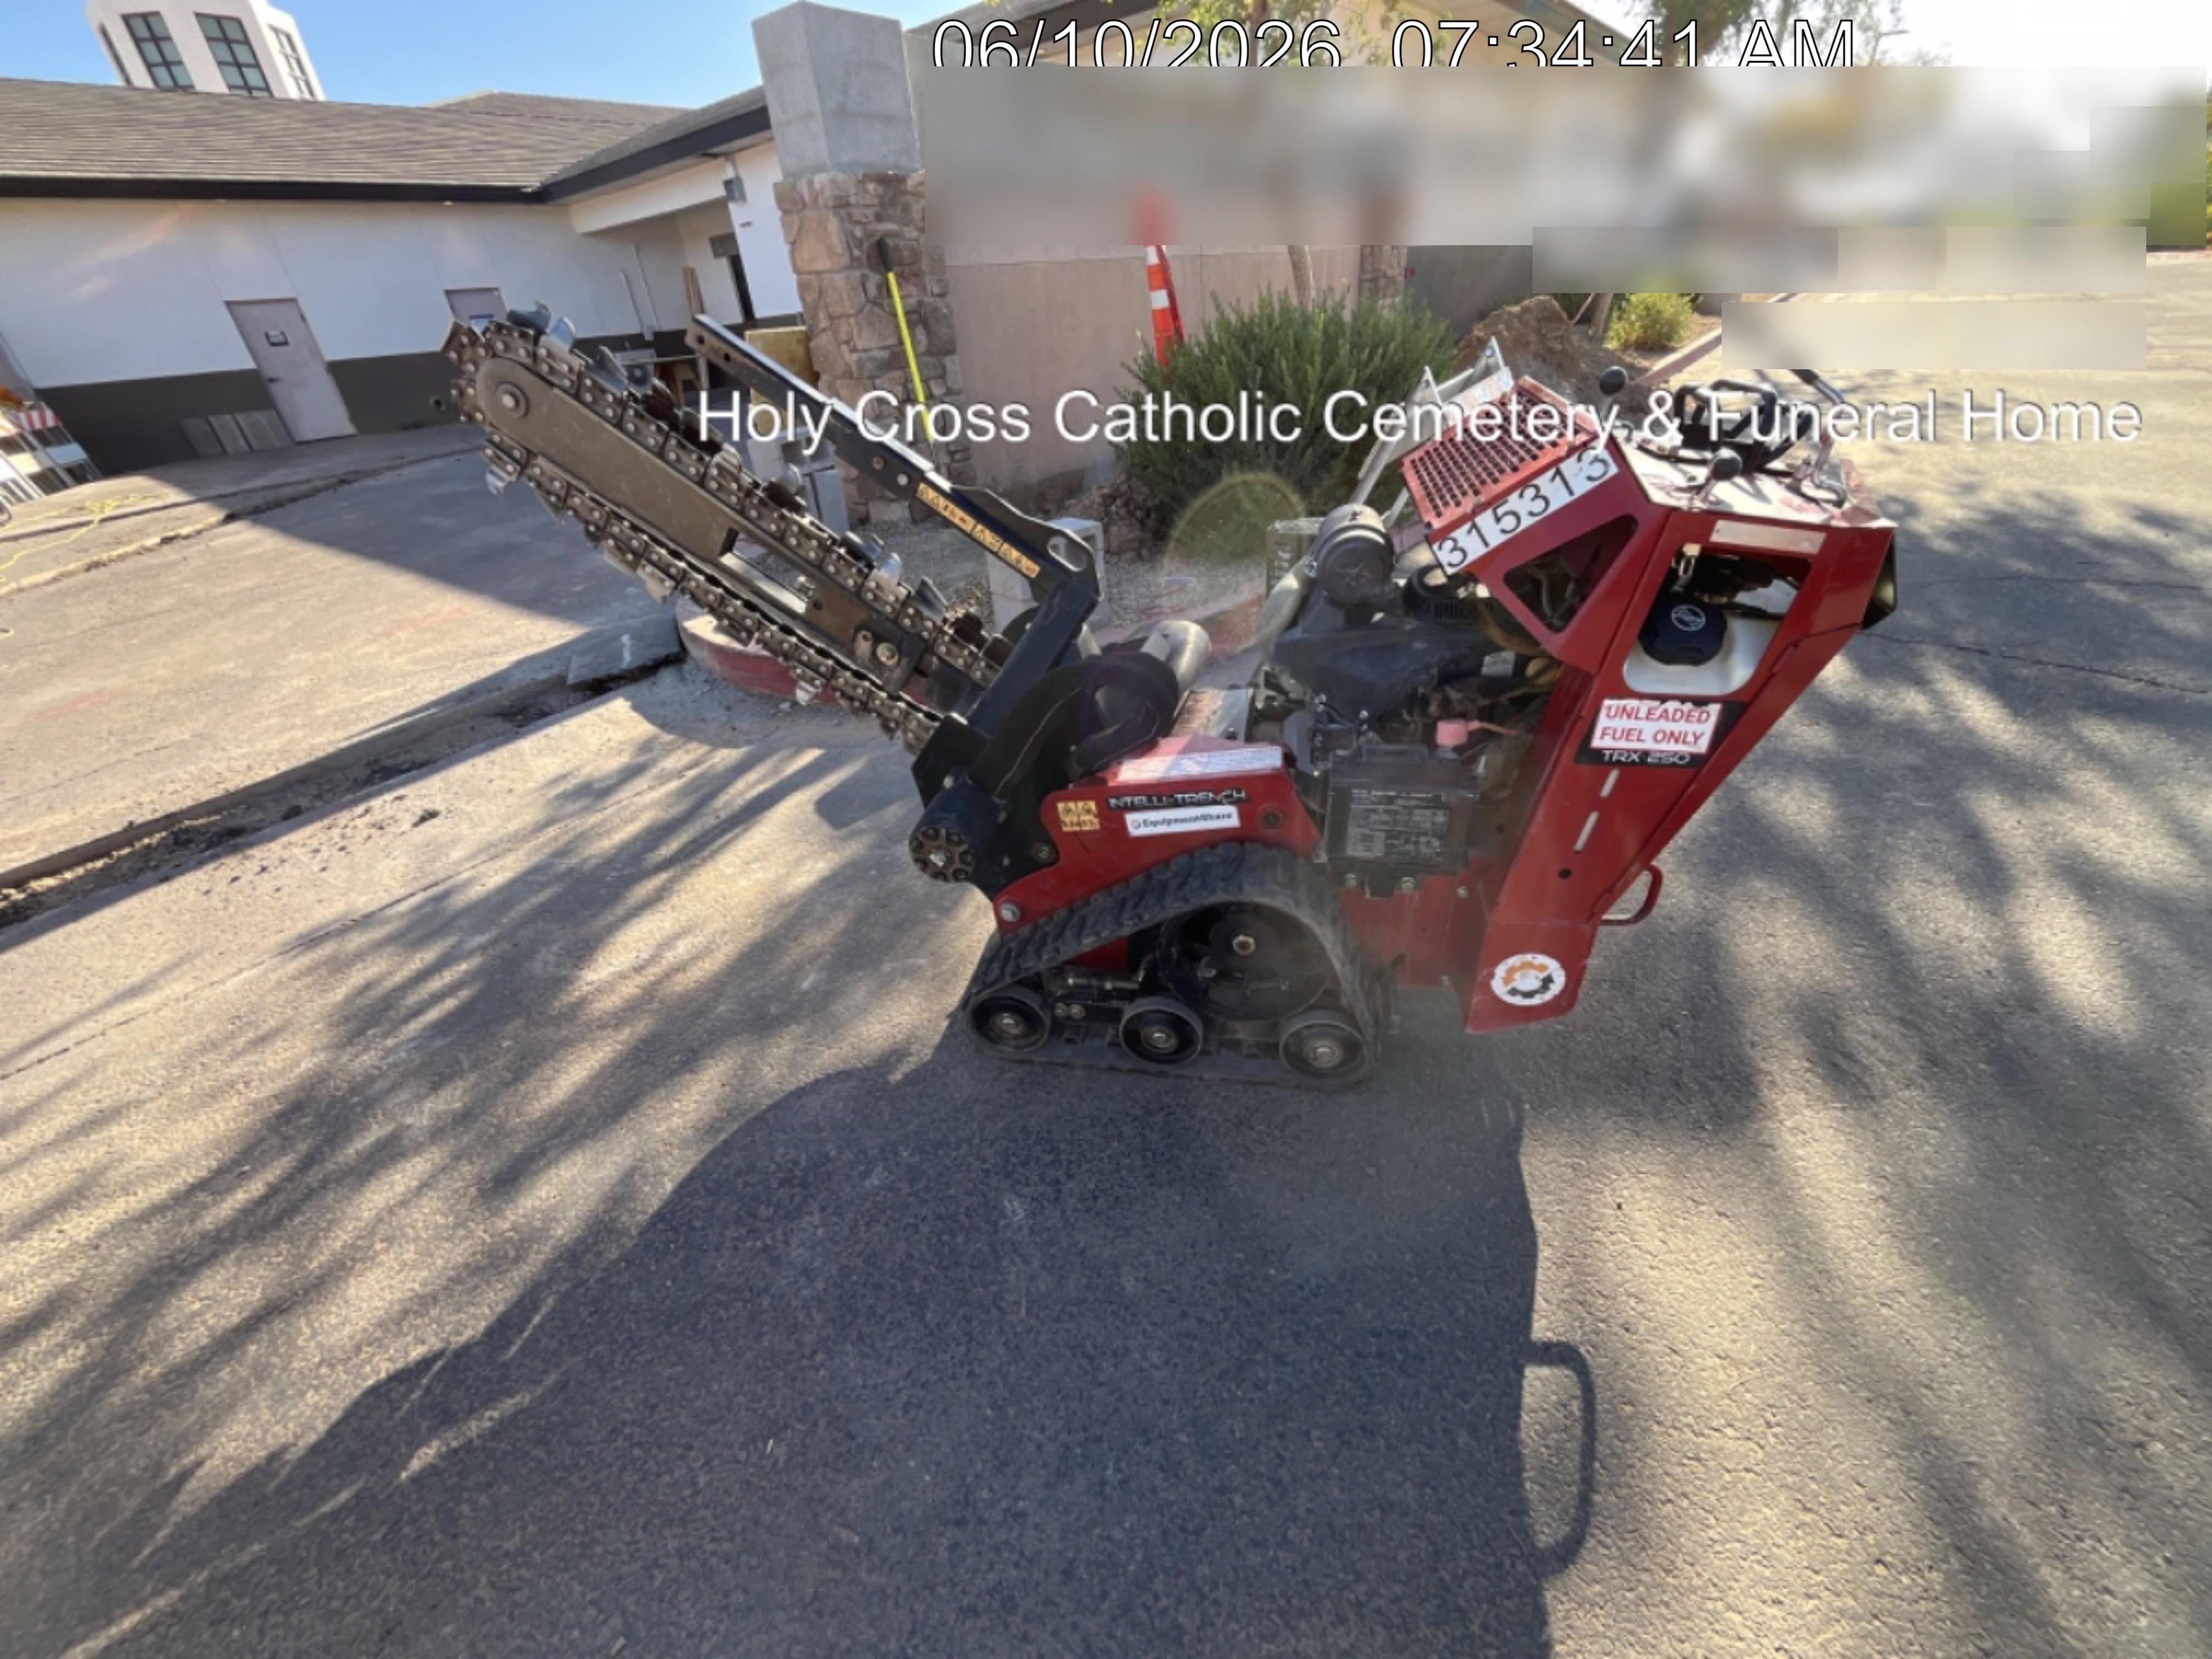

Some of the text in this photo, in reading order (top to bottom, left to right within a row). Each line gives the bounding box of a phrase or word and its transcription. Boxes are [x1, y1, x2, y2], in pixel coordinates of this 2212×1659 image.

[1437, 445, 1611, 568] 315313
[1605, 705, 1711, 724] UNLEADED
[1599, 726, 1705, 745] FUEL ONLY
[1602, 750, 1641, 762] TRX
